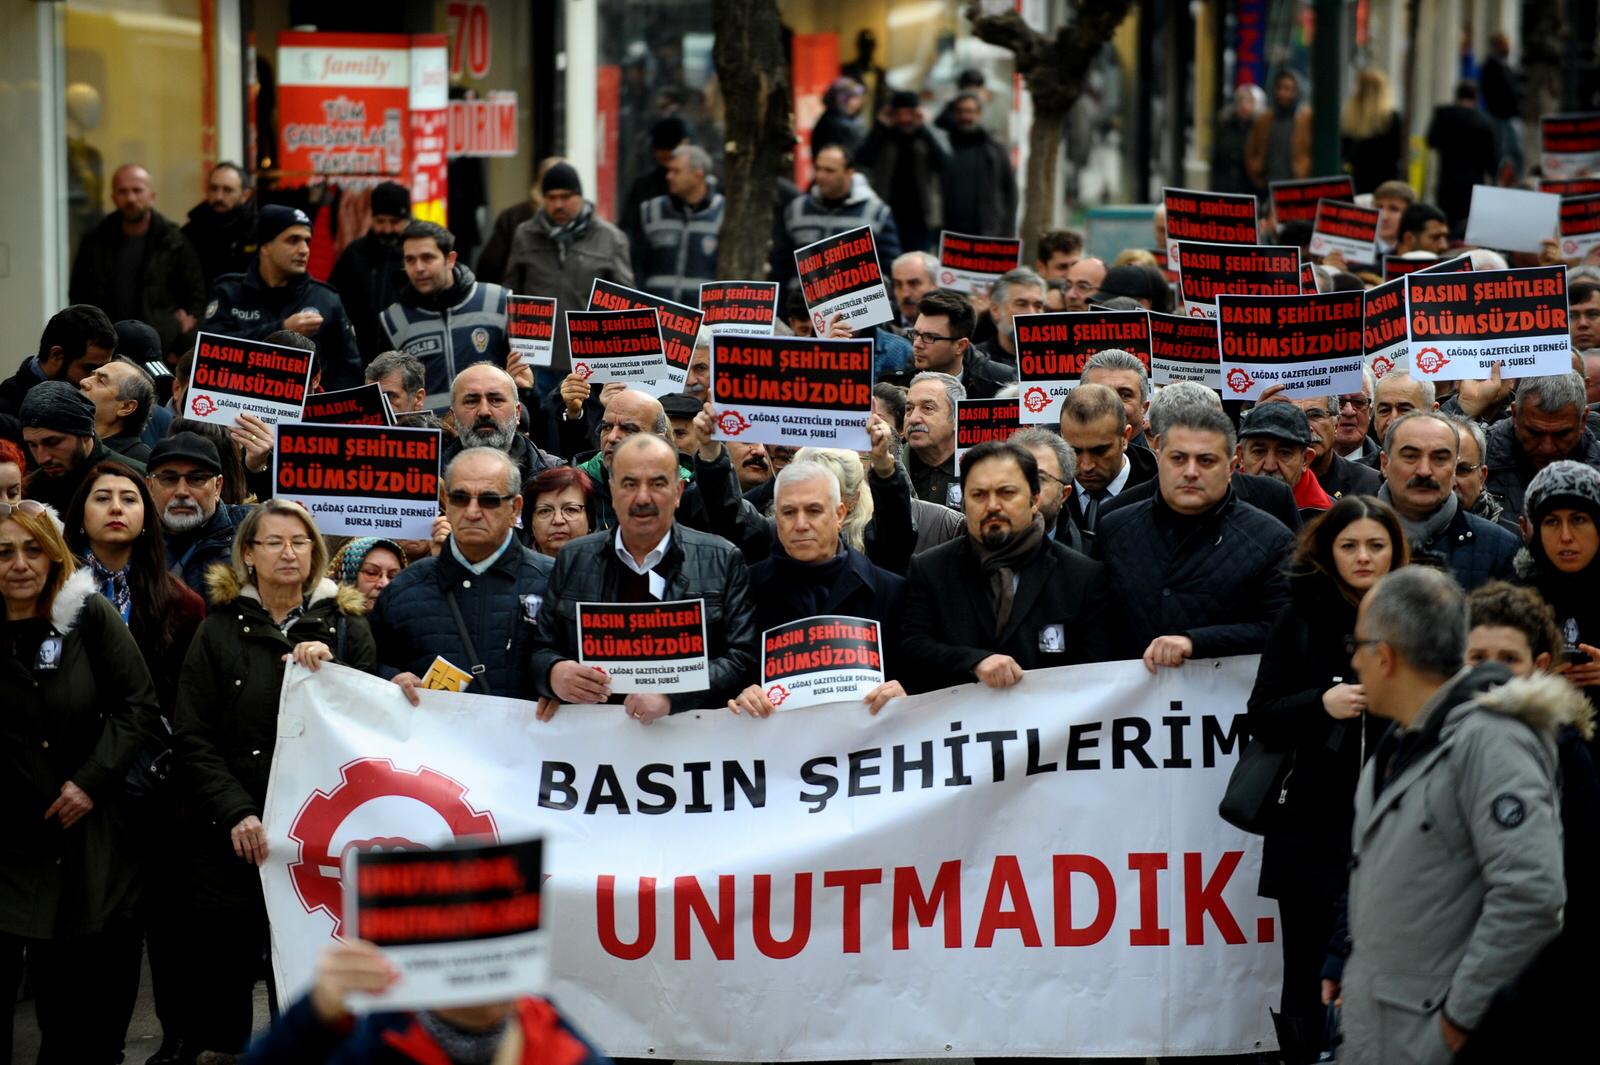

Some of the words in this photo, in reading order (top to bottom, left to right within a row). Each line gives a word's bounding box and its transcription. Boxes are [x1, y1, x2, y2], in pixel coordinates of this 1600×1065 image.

[321, 53, 391, 79] family
[322, 96, 366, 123] TÜM
[285, 124, 392, 151] ÇALIŞANLA
[1168, 216, 1255, 242] ÖLÜMSÜZDÜR
[799, 254, 822, 276] BASIN
[824, 232, 872, 269] ŞEHİTLERİ
[1182, 252, 1221, 270] BASIN
[1226, 252, 1297, 276] ŞEHİTLERİ
[725, 285, 774, 302] ŞEHİTLERİ
[803, 261, 879, 302] ÖLÜMSÜZDÜR
[1411, 284, 1467, 304] BASIN
[1473, 271, 1563, 306] ŞEHİTLERİ
[592, 290, 631, 311] BASIN
[1222, 306, 1271, 324] BASIN
[1277, 297, 1361, 329] ŞEHİTLERİ
[1365, 291, 1398, 318] ASIN
[570, 319, 599, 332] BASIN
[602, 313, 656, 334] ŞEHİTLERİ
[1019, 325, 1068, 343] BASIN
[1073, 317, 1147, 346] ŞEHİTLERİ
[1413, 305, 1567, 336] ÖLÜMSÜZDÜR
[408, 340, 437, 355] OLIS
[572, 334, 660, 354] ÖLÜMSÜZDÜR
[1223, 328, 1362, 357] ÖLÜMSÜZDÜR
[1446, 346, 1478, 359] ÇAĞDAŞ
[1480, 343, 1530, 356] GAZETECİLER
[1533, 340, 1568, 352] DERNEĞİ
[200, 343, 244, 363] BASIN
[248, 351, 308, 374] ŞEHİTLERİ
[716, 346, 773, 367] BASIN
[779, 345, 869, 373] ŞEHİTLERİ
[1021, 348, 1150, 375] ÖLÜMSR
[1251, 370, 1279, 380] ÇAĞDAŞ
[1281, 366, 1327, 379] GAZETECİLER
[1329, 361, 1361, 373] DERNEĞİ
[1479, 357, 1506, 369] BURA
[1508, 355, 1536, 368] ŞUBESİ
[196, 364, 305, 401] ÖLÜMSÜZDÜR
[668, 373, 684, 383] NEĞİ
[716, 372, 870, 405] ÖLÜMSÜZDÜR
[1307, 376, 1331, 389] ŞUBESİ
[748, 413, 780, 425] ÇAĞDAŞ
[782, 414, 832, 426] GAZETECİLER
[835, 416, 868, 428] DERNEĞ
[959, 407, 989, 421] BASIN
[280, 435, 339, 455] BASIN
[345, 433, 437, 461] ŞEHİTLERİ
[781, 428, 808, 437] BURSA
[810, 429, 837, 440] ŞUBESİ
[279, 462, 437, 495] ÖLÜMSÜZDÜR
[311, 502, 344, 514] ÇAĞDAŞ
[347, 503, 398, 516] GAZETECİLER
[400, 506, 436, 517] DERNEĞİ
[345, 518, 373, 527] BURSA
[374, 518, 402, 530] ŞUBESİ
[582, 613, 625, 629] BASIN
[629, 605, 700, 633] ŞEHİTLERİ
[583, 632, 704, 657] ÖLÜMSÜZDÜR
[766, 629, 804, 652] BASIN
[808, 621, 877, 645] ŞEHİTLERİ
[635, 665, 675, 675] GAZETECİLER
[765, 645, 880, 677] ÖLÜMSÜZDÜR
[635, 677, 656, 685] BURSA
[813, 687, 834, 695] BURSA
[538, 759, 766, 815] BASIN
[596, 851, 1275, 960] UNUTMADIK.
